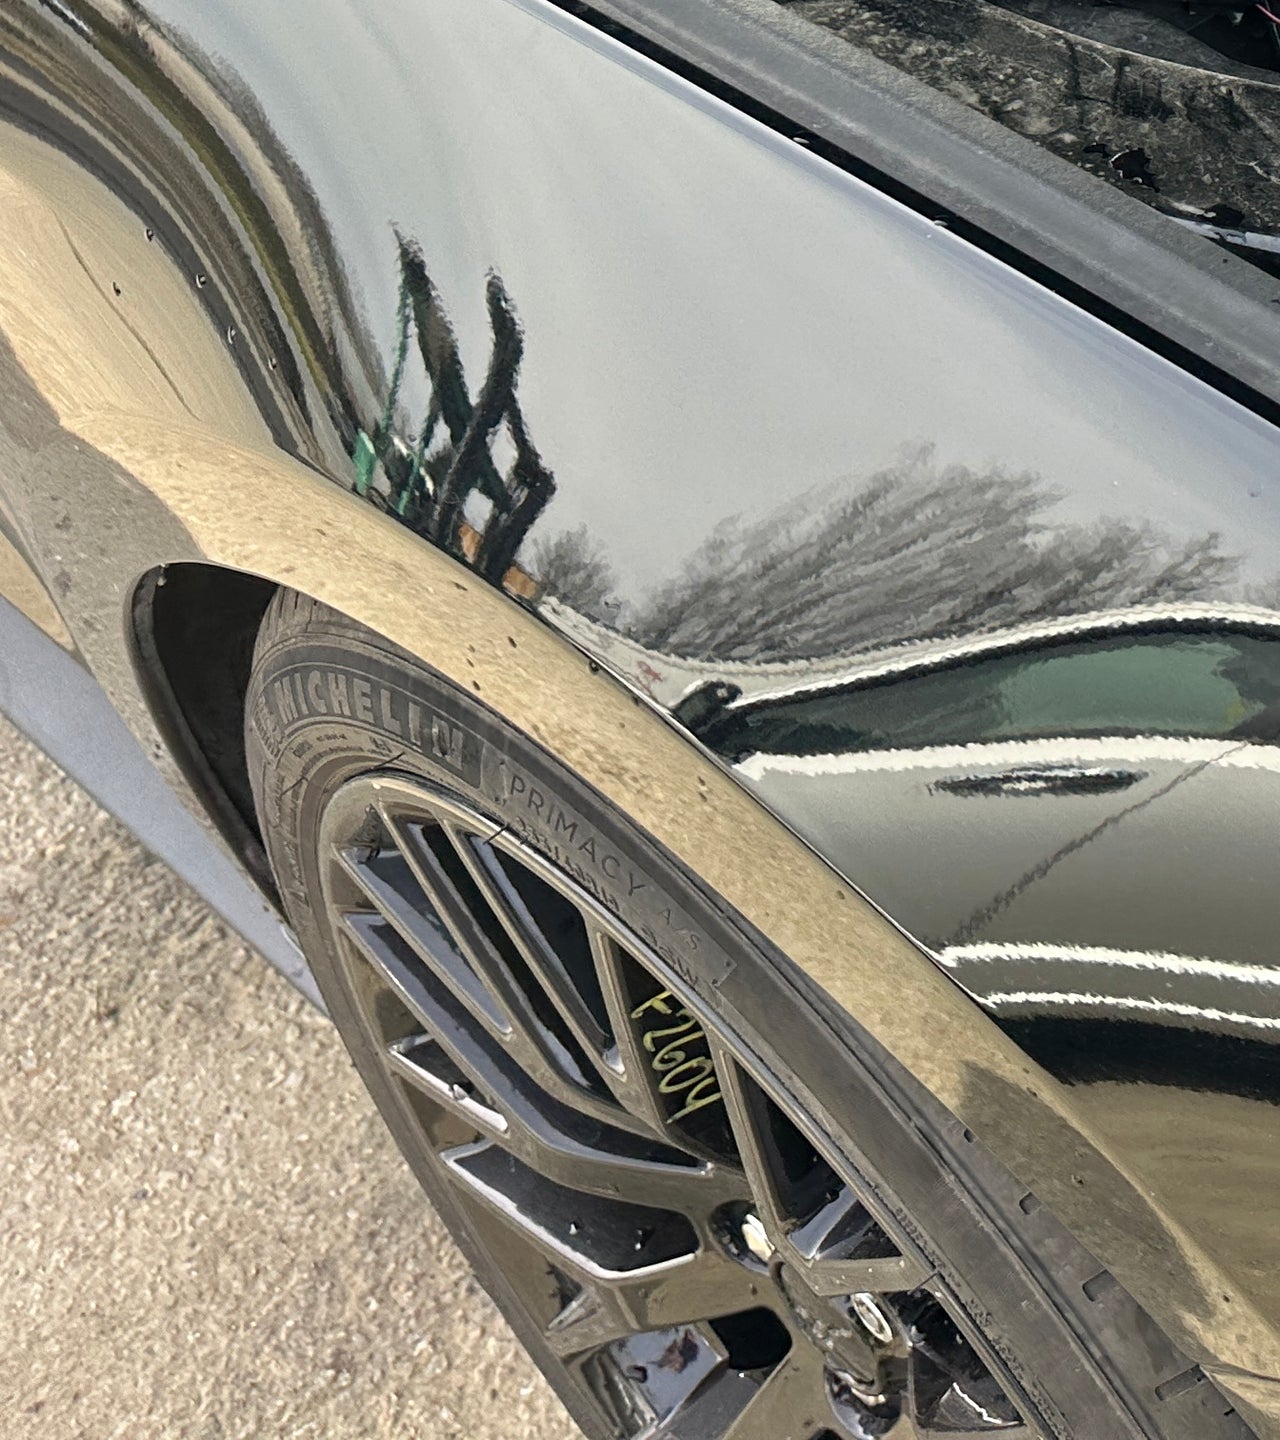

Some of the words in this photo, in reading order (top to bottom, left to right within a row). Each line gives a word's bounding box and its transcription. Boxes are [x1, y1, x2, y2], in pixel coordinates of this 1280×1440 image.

[273, 669, 465, 772] MICHELIN
[509, 774, 646, 897] PRIMACY
[657, 907, 703, 951] A/S
[631, 989, 722, 1125] F2604
